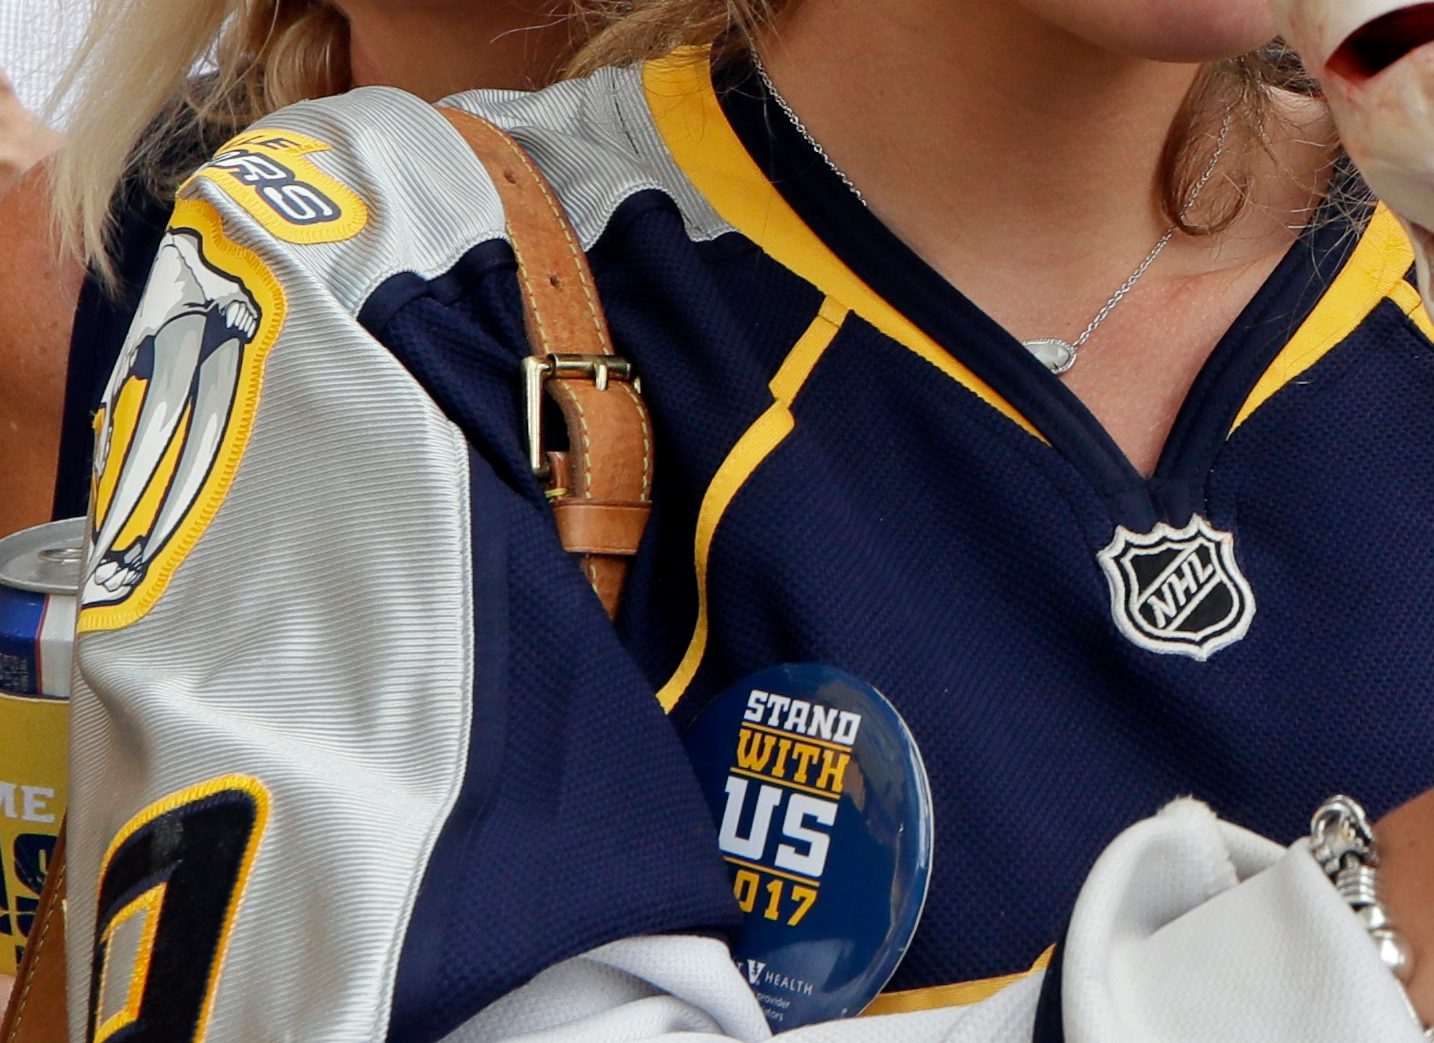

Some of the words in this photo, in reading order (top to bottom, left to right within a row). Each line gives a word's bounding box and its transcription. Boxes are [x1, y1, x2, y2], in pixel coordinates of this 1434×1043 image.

[1147, 551, 1215, 629] NHL
[743, 689, 862, 745] STAND
[736, 728, 851, 793] WITH
[718, 775, 839, 878] US
[733, 869, 818, 926] 017
[764, 971, 813, 996] HEALTH
